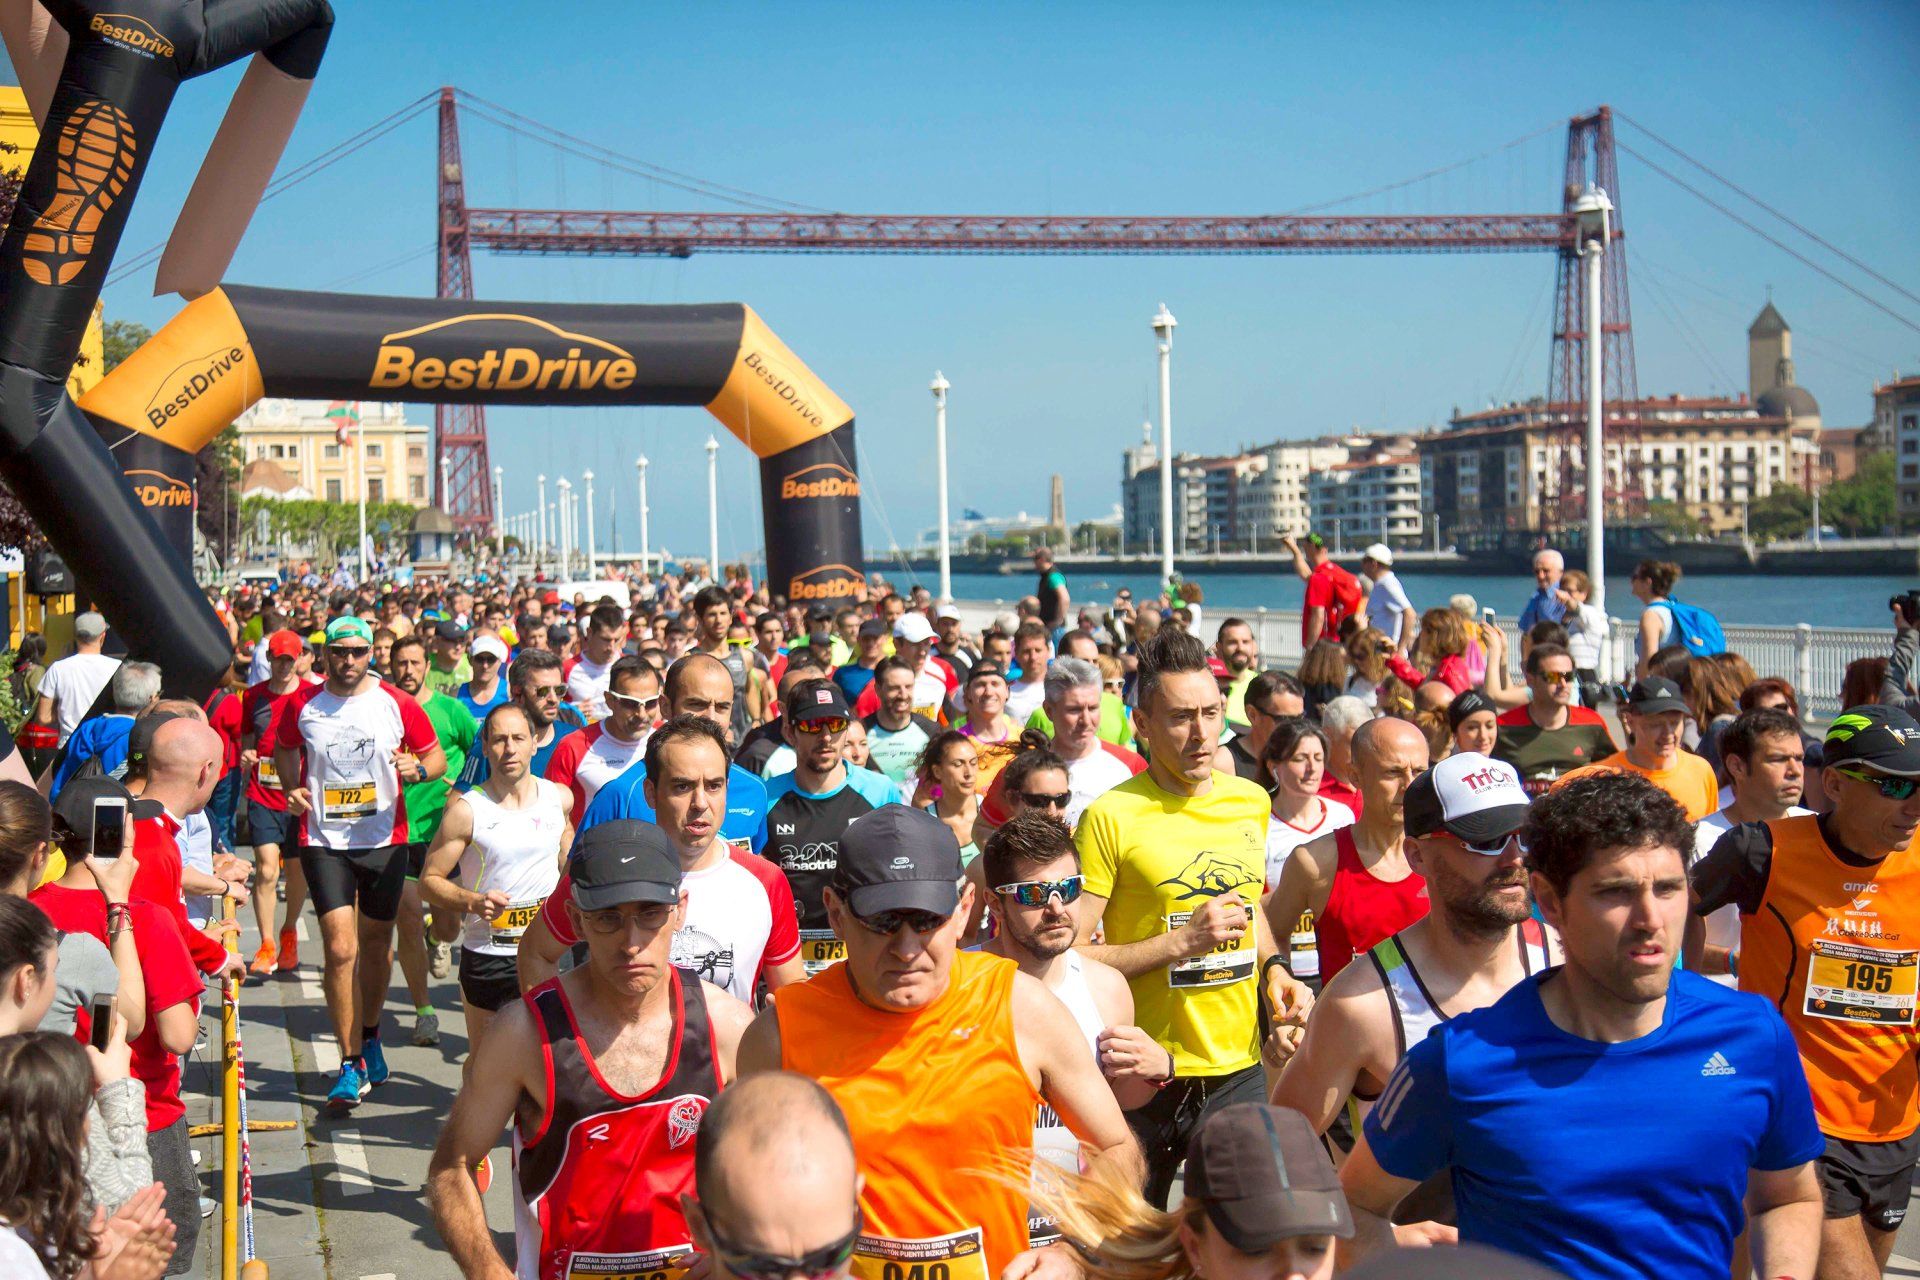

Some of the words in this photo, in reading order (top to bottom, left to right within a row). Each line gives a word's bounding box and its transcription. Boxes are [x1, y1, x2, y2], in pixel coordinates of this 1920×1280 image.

[90, 16, 175, 57] BestDrive
[368, 345, 637, 390] BestDrive
[147, 346, 244, 430] BestDrive
[744, 352, 823, 428] BestDrive
[338, 790, 362, 804] 722
[776, 823, 795, 833] NN
[1843, 881, 1879, 893] amic
[813, 940, 844, 960] 673
[1844, 963, 1893, 993] 195
[1843, 1008, 1882, 1019] BestDrive
[1701, 1066, 1737, 1077] adidas
[879, 1240, 902, 1249] ZUBIKO
[902, 1242, 931, 1250] MARATOI
[931, 1240, 950, 1248] ERDIA
[900, 1250, 925, 1258] PUENTE
[925, 1248, 950, 1257] BIZKAIA
[600, 1256, 622, 1264] ZUBIKO
[622, 1256, 647, 1264] MARATOI
[619, 1262, 642, 1270] PUENTE
